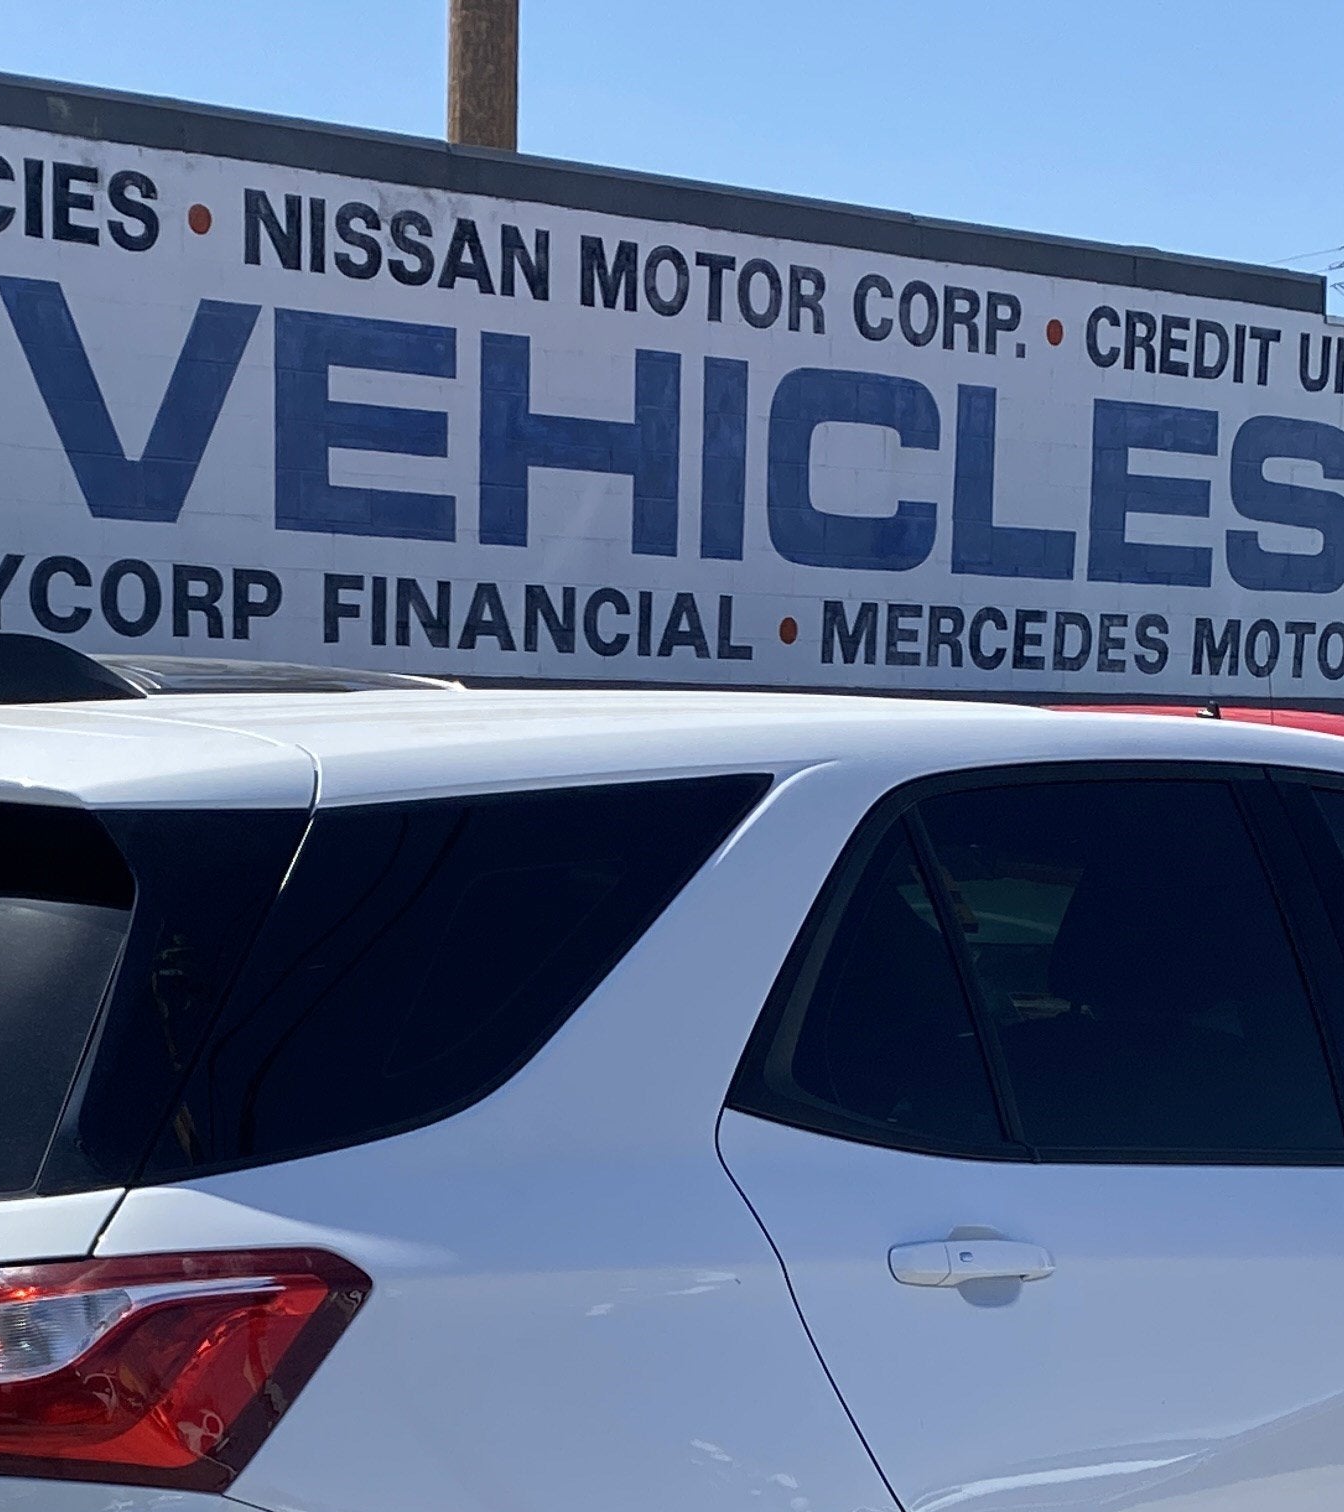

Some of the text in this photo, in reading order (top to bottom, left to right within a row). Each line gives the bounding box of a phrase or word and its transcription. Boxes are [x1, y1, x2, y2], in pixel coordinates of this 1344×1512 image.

[244, 188, 549, 301] NISSAN
[580, 235, 825, 334] MOTOR
[854, 274, 1026, 358] CORP.
[1086, 305, 1281, 386] CREDIT
[324, 573, 753, 660] FINANCIAL
[821, 600, 1169, 673] MERCEDES
